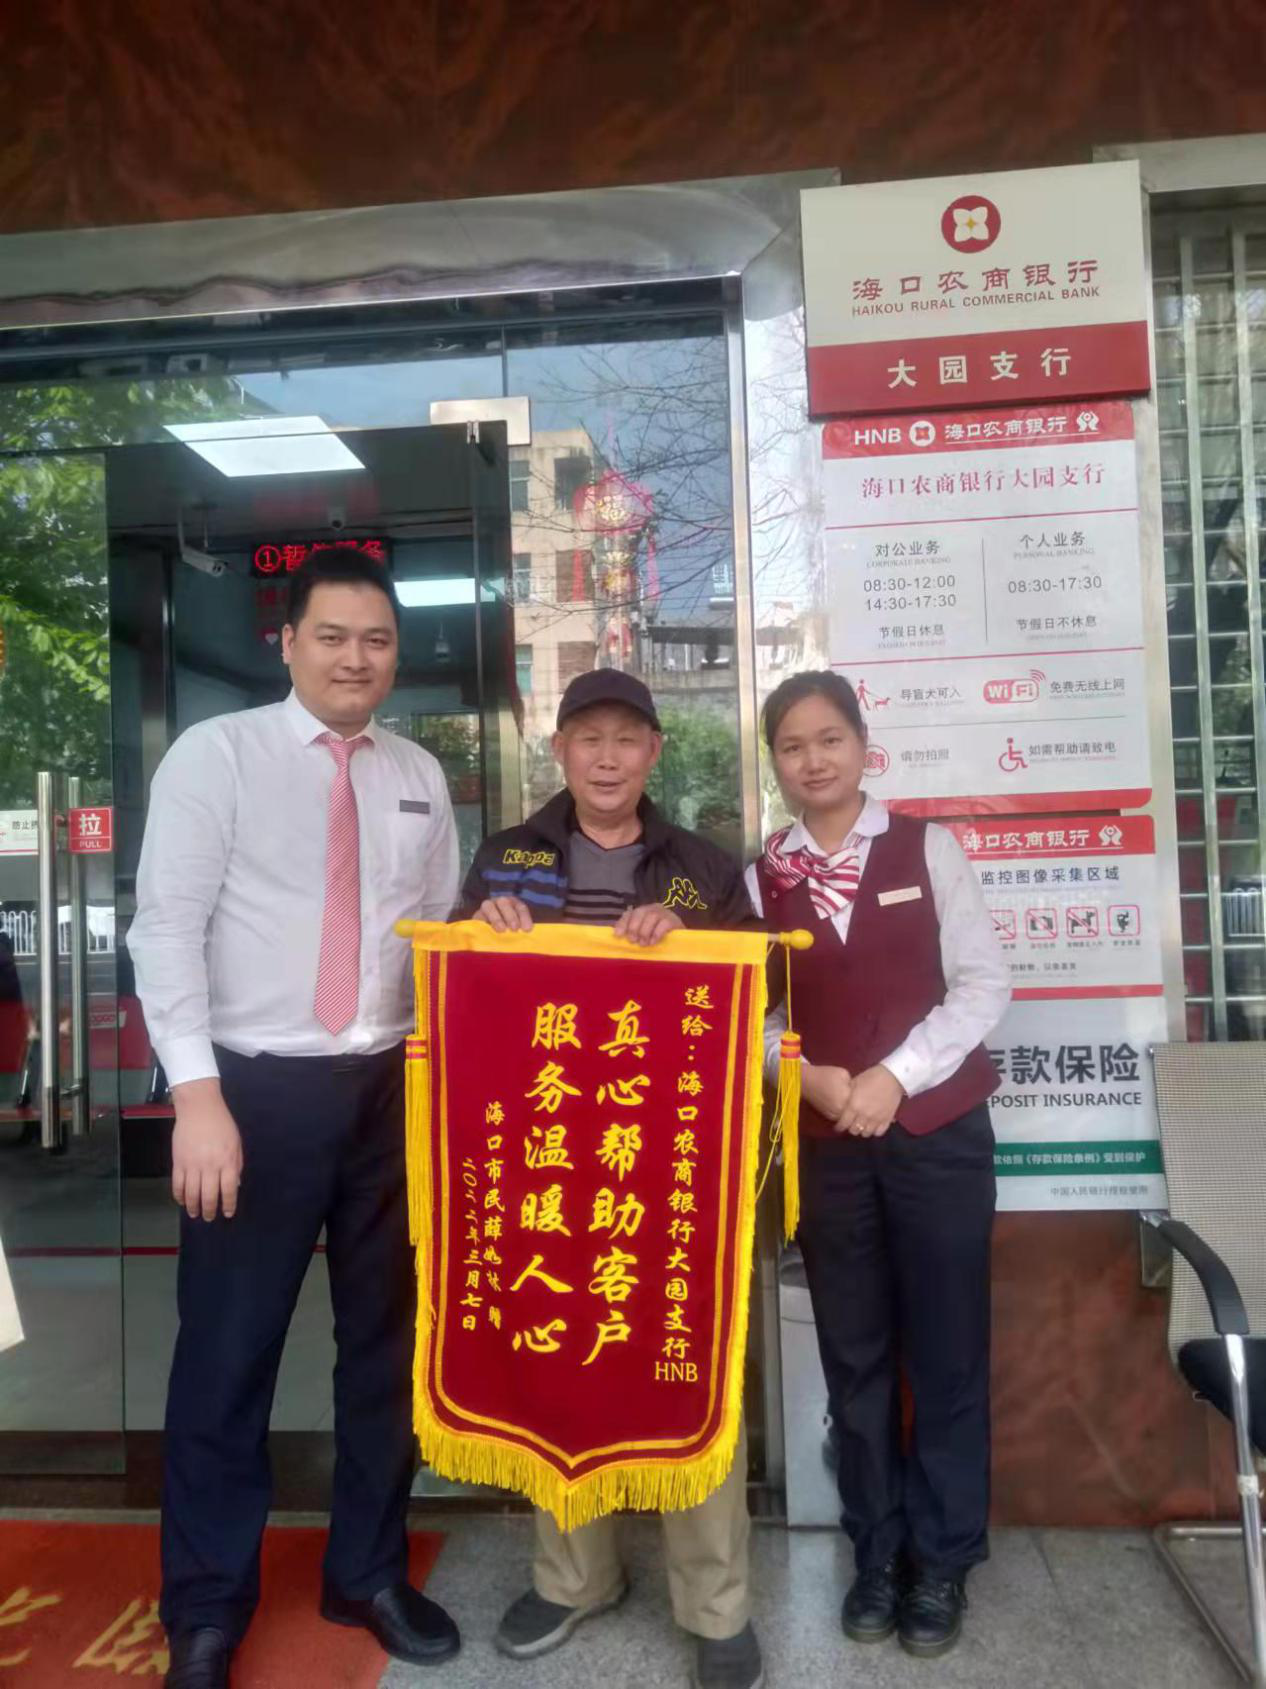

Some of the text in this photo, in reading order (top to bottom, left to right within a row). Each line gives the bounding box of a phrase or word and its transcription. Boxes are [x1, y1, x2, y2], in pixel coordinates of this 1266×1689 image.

[853, 260, 1098, 300] 海口农商银行
[852, 286, 1099, 317] HAIKOU RURAL COMMERCIAL BANK
[887, 348, 1071, 388] 大园支行
[854, 427, 901, 445] HNB
[945, 416, 1067, 439] 海口农商银行
[862, 463, 1105, 498] 海口农商银行大园支行
[875, 540, 940, 557] 对公业务
[1020, 531, 1085, 548] 个人业务
[863, 575, 956, 592] 08:30-12:00
[1008, 575, 1102, 593] 08:30-17:30
[866, 593, 957, 611] 14:30-17:30
[879, 624, 945, 639] 节假日休息
[1016, 615, 1097, 631] 节假日不休息
[1050, 678, 1125, 694] 免费无线上网
[79, 813, 102, 836] 拉
[79, 840, 102, 848] PULL
[962, 829, 1090, 850] 海口农商银行
[981, 866, 1120, 885] 监控图像采集区域
[990, 1092, 1142, 1108] POSIT INSURANCE
[510, 1003, 582, 1354] 服务温暖人心
[582, 1000, 651, 1366] 真心帮助客户
[655, 1361, 698, 1383] HNB
